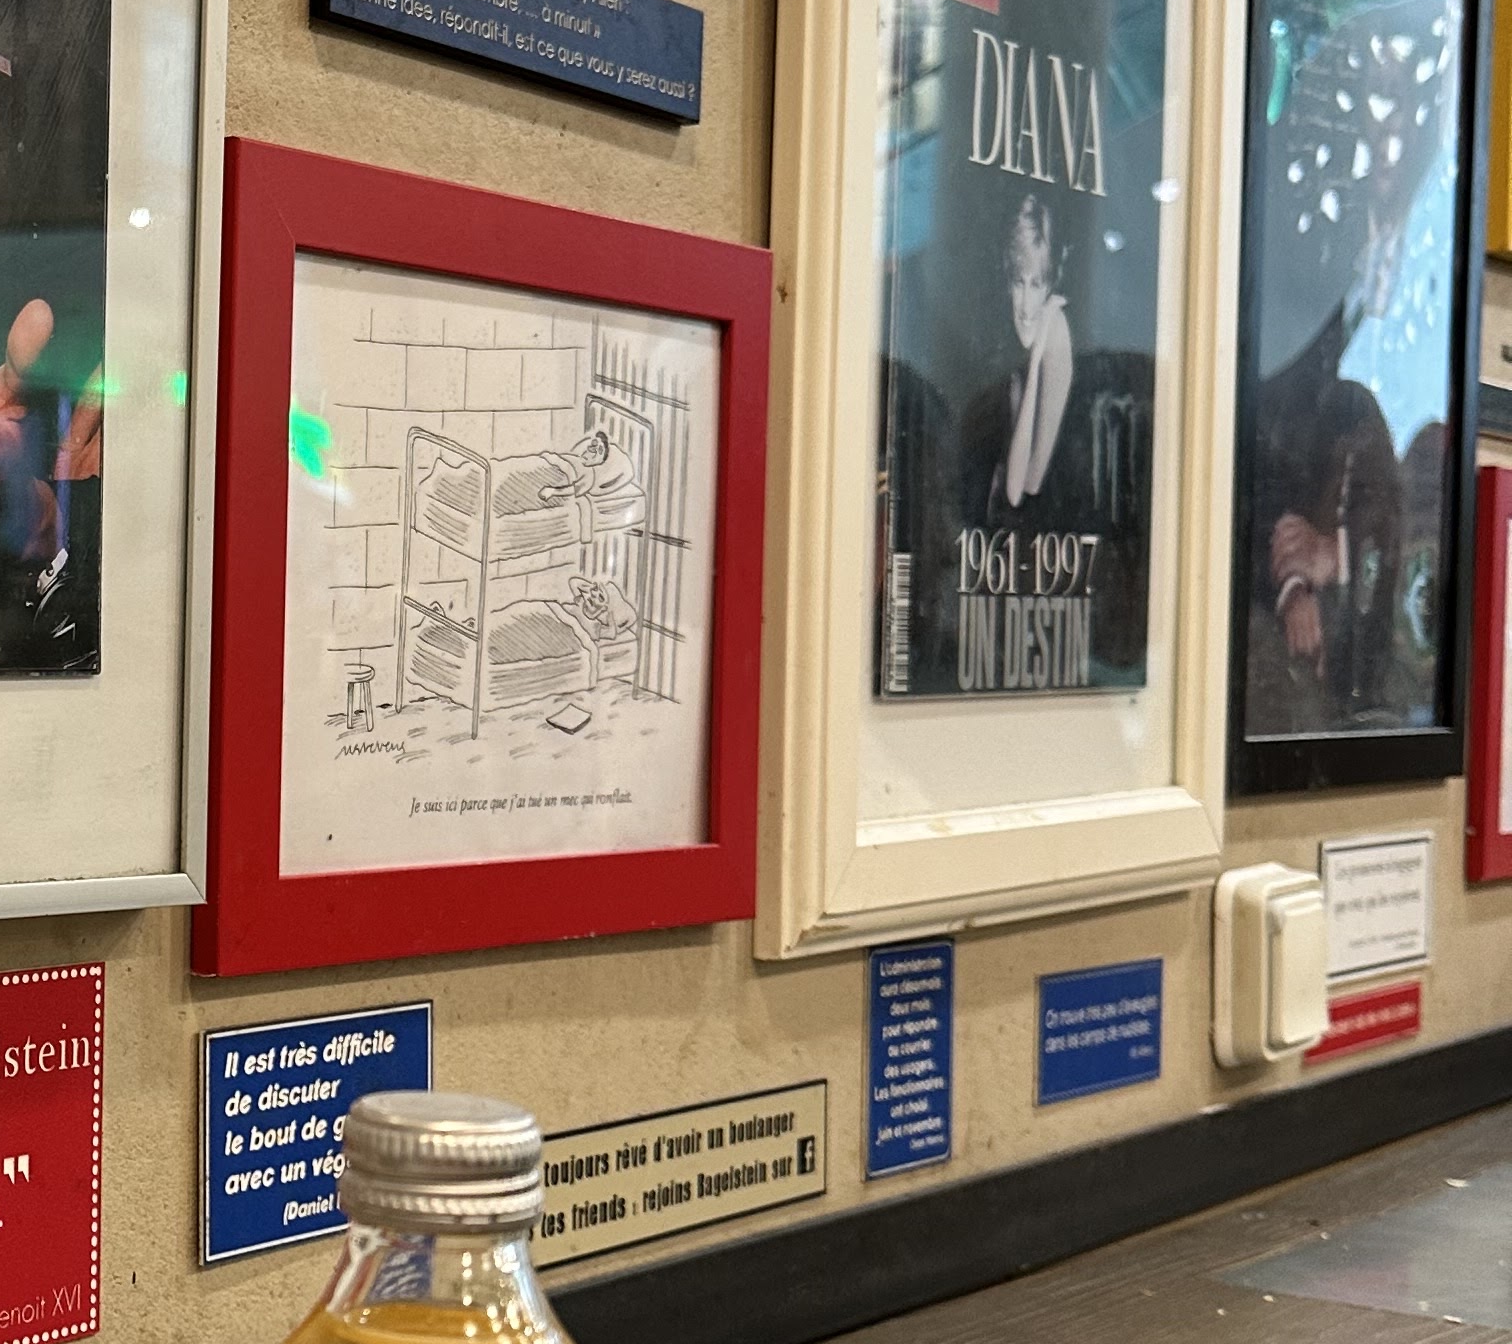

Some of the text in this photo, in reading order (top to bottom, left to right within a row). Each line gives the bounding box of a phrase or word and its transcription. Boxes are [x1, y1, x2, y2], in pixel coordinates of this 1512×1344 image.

[968, 28, 1108, 197] DIANA
[955, 527, 1100, 595] 1961-1997
[958, 596, 1091, 691] UN DESTIN
[224, 1030, 394, 1078] Il est très difficile
[224, 1078, 340, 1117] de discuter
[224, 1115, 327, 1156] le bout de
[543, 1112, 794, 1188] toujours rêvé d'avoir un boulanger
[224, 1160, 306, 1195] avec un
[571, 1196, 626, 1231] friends
[642, 1181, 692, 1213] rejoins
[697, 1162, 766, 1198] Bagelstein
[772, 1156, 792, 1180] sur
[52, 1283, 80, 1316] XVI
